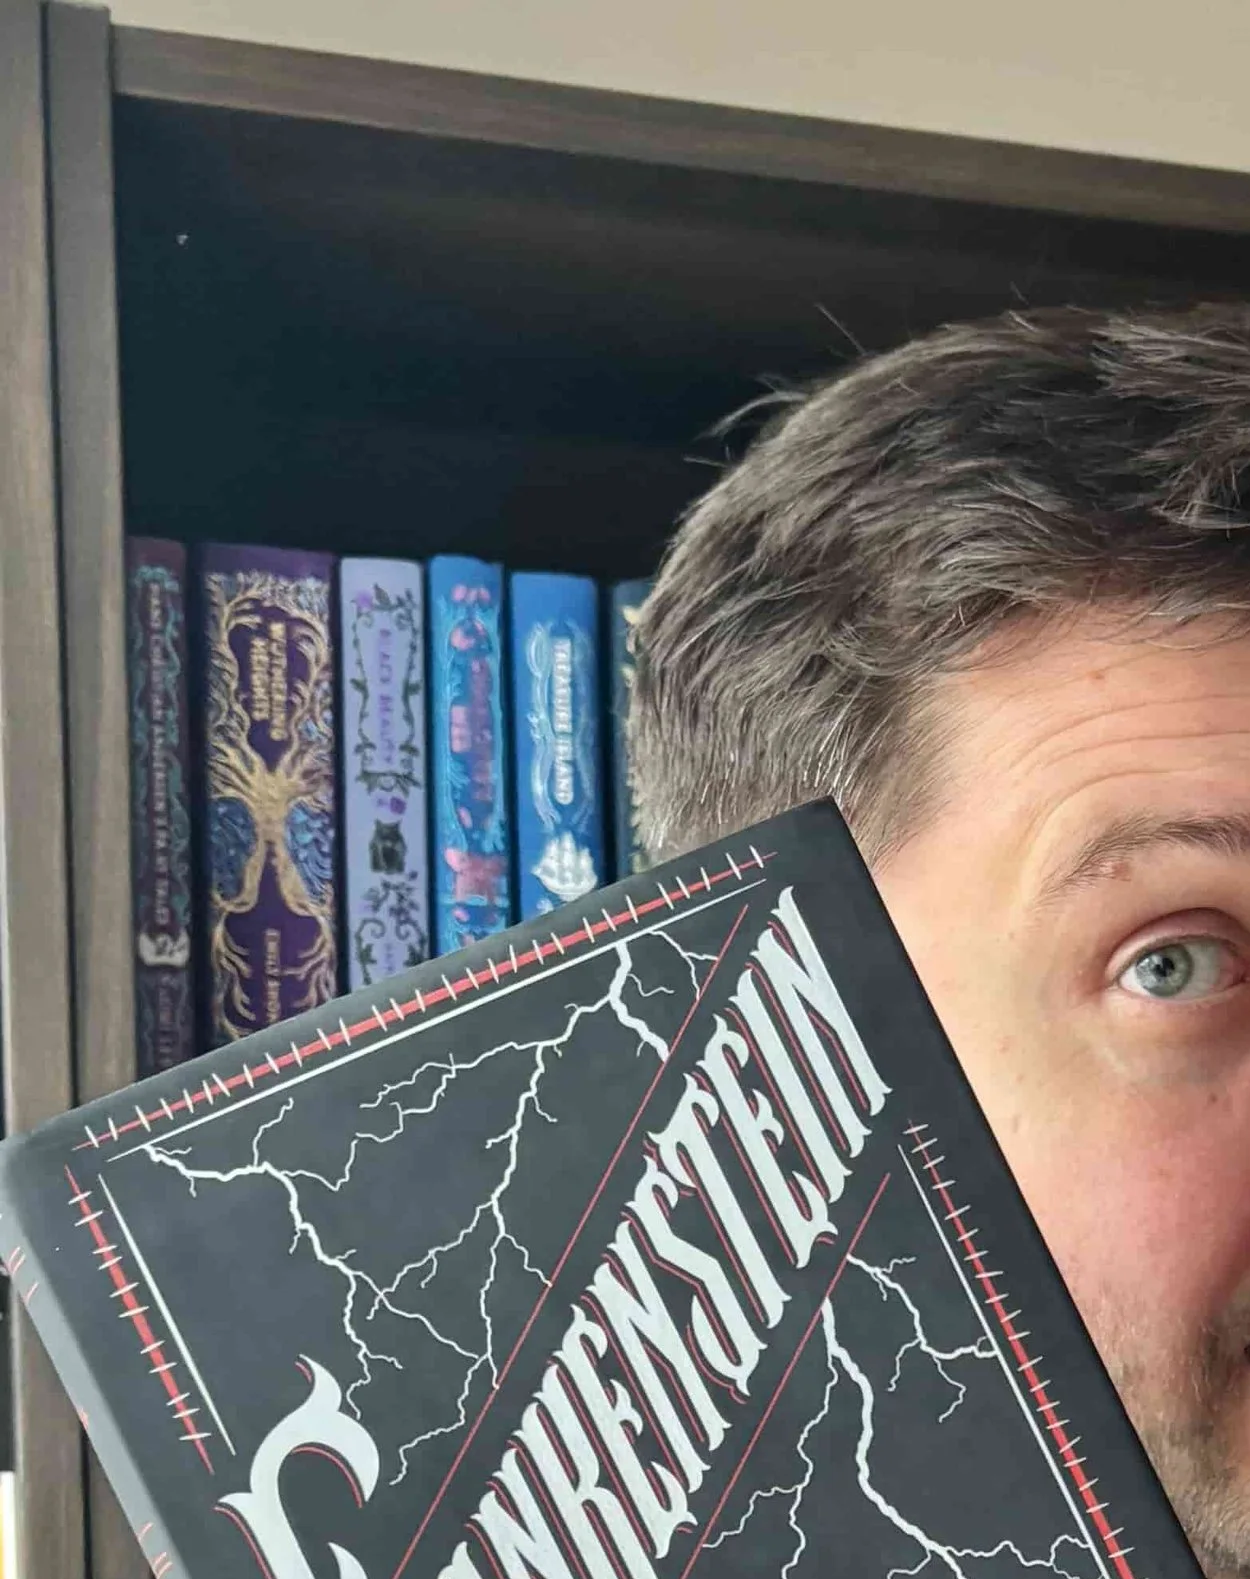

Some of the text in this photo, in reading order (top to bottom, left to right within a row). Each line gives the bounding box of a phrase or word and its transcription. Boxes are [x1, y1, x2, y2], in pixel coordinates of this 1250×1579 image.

[251, 635, 270, 722] HEIGHTS
[269, 621, 287, 741] WUTHERING
[553, 638, 574, 805] TREASURE ISLAND
